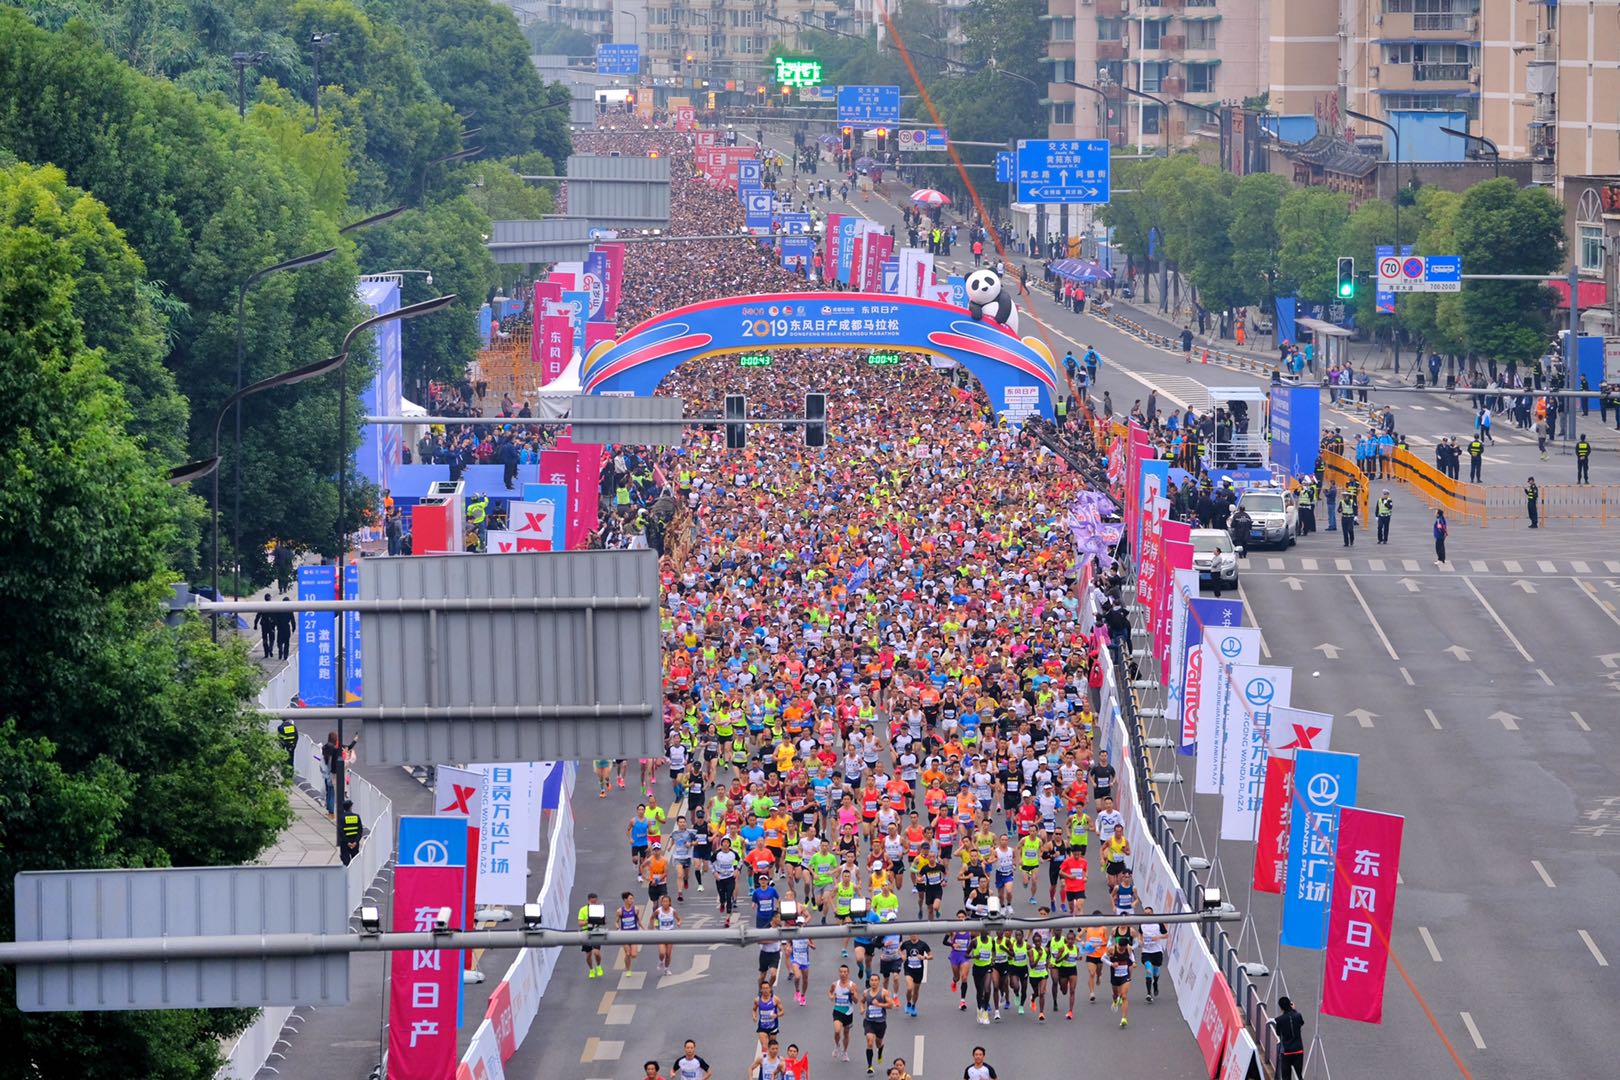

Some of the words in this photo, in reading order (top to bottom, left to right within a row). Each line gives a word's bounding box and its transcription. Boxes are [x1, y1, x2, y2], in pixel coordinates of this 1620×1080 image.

[701, 134, 710, 144] F
[1048, 142, 1080, 150] 交大路
[714, 154, 722, 166] E
[744, 166, 755, 178] D
[753, 196, 766, 210] C
[790, 222, 804, 234] B
[1385, 264, 1396, 273] 70
[862, 306, 899, 314] 东风日产
[742, 320, 788, 337] 2019
[790, 320, 899, 331] 东风日产成都马拉松
[318, 629, 330, 680] 激情起跑
[1237, 784, 1246, 812] PLAZA
[491, 768, 512, 874] 自贡万达广场
[1302, 811, 1311, 856] WANDA
[1305, 812, 1334, 903] 万达广场
[1298, 859, 1308, 900] PLAZA
[1341, 850, 1380, 981] 东风日产
[410, 906, 441, 1048] 东风日产
